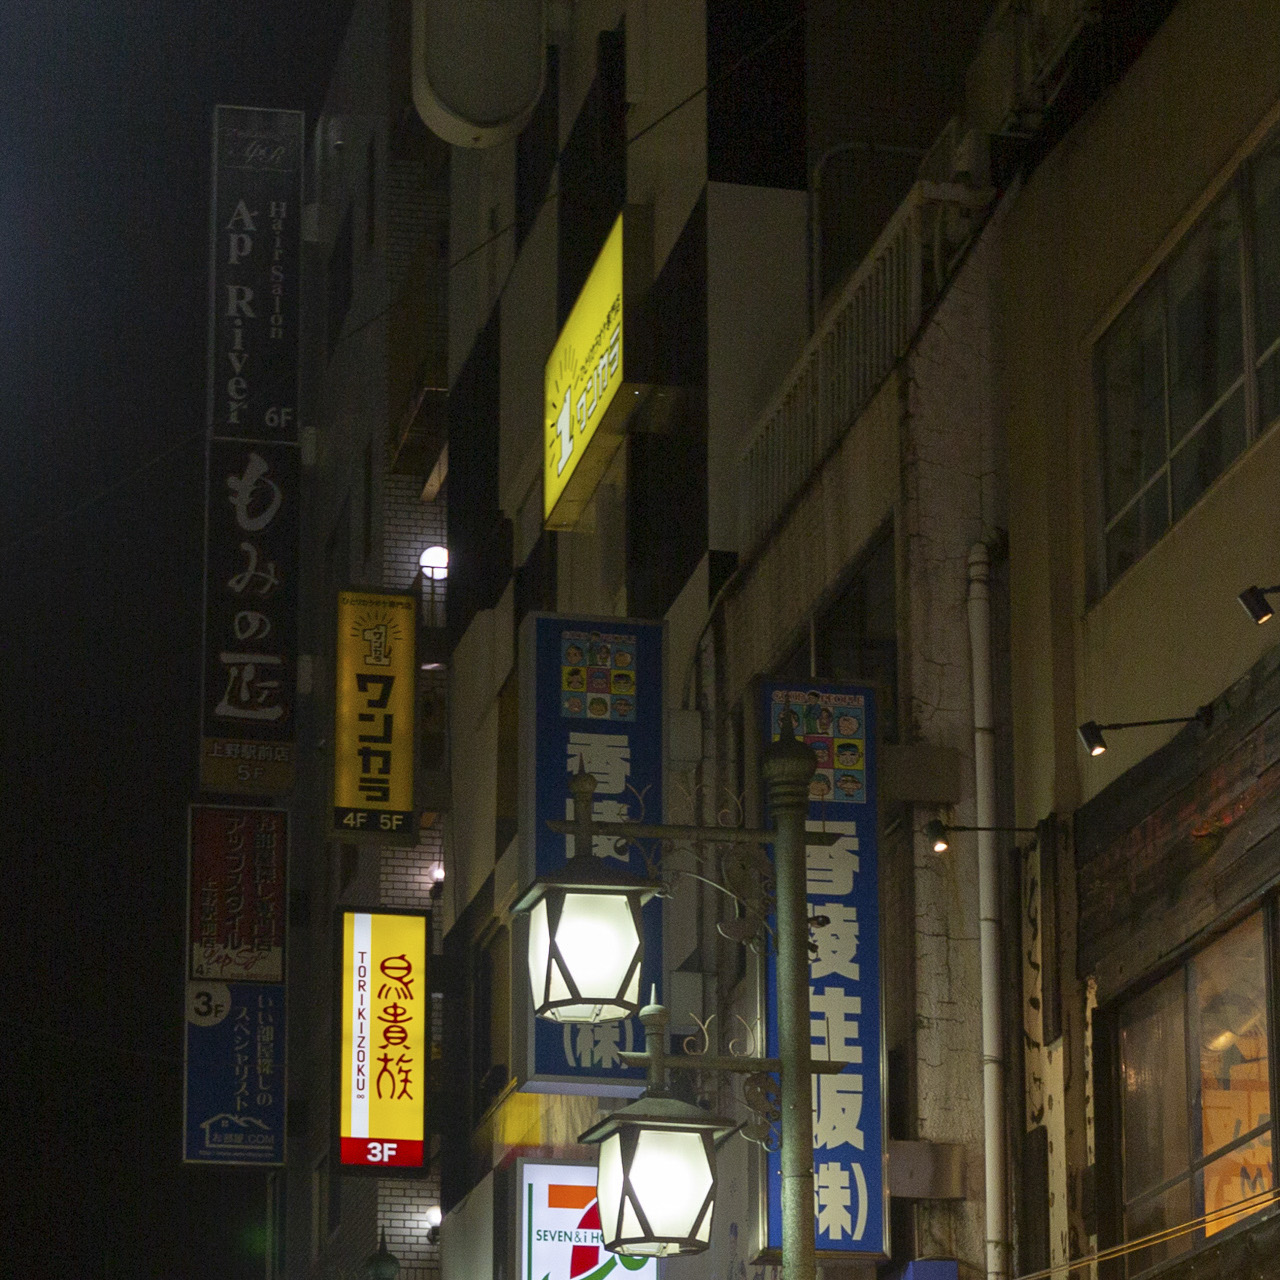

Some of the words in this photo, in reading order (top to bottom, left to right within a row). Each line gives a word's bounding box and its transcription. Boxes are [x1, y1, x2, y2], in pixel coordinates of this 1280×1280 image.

[225, 284, 254, 424] River
[265, 406, 294, 428] 6F
[356, 673, 396, 802] ワンカラ
[343, 812, 367, 828] 4F
[379, 814, 404, 830] 5F
[194, 990, 225, 1019] 3F
[356, 951, 367, 1091] TORIKIZOKU
[367, 1142, 397, 1162] 3F
